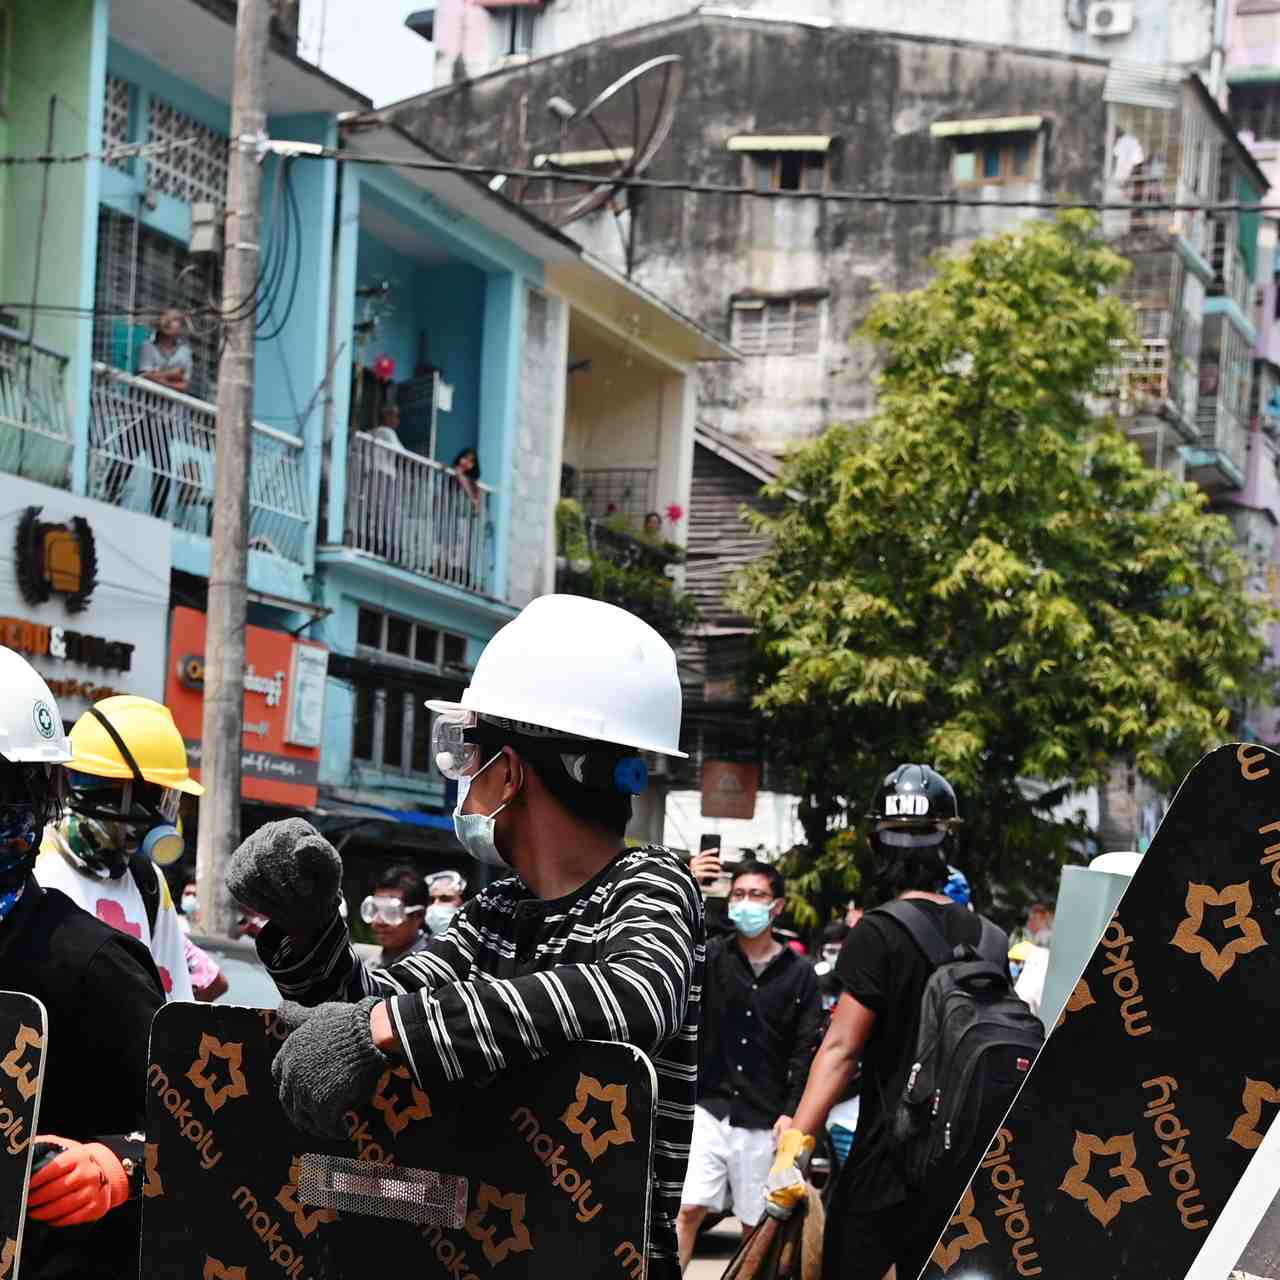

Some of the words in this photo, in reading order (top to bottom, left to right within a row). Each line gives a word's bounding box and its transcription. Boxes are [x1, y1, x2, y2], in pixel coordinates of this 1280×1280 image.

[885, 796, 930, 816] KMD
[1102, 910, 1151, 1038] makp
[149, 1063, 223, 1169] makply
[511, 1106, 602, 1222] makply
[1142, 1076, 1208, 1231] makply
